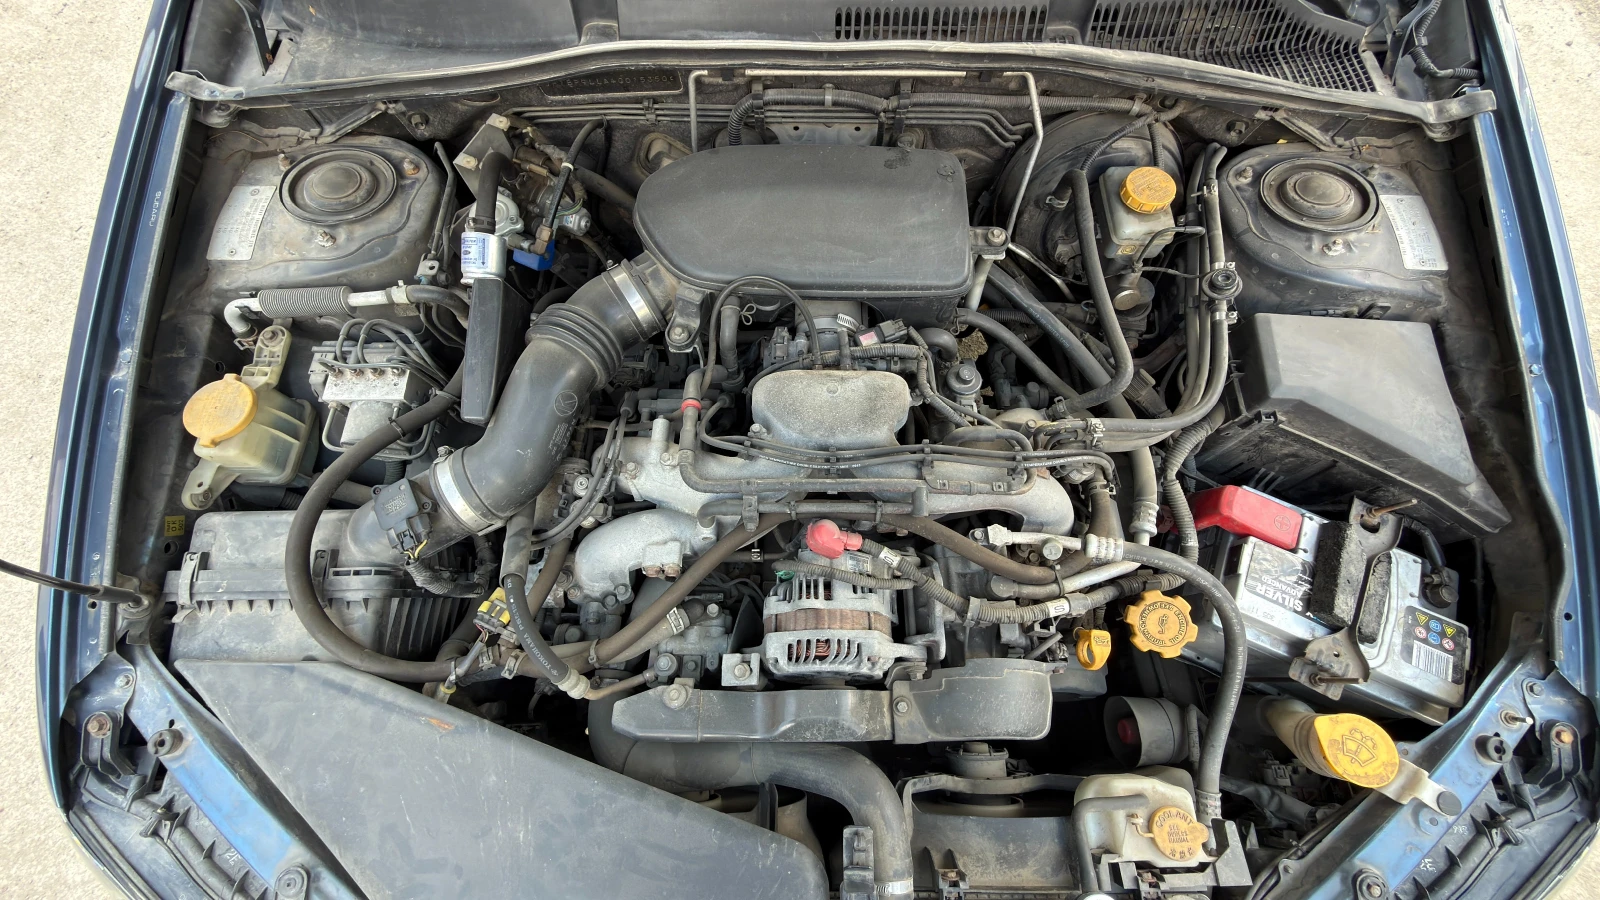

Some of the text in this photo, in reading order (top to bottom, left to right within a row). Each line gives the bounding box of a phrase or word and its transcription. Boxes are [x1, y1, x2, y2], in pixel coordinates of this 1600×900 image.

[149, 191, 162, 227] SUBARU
[1257, 583, 1304, 612] SILVER
[1261, 576, 1305, 597] ADVANCED
[1169, 609, 1185, 645] ENGINE OIL
[523, 632, 551, 671] YOKOHAMA
[1156, 810, 1194, 828] COOLANT
